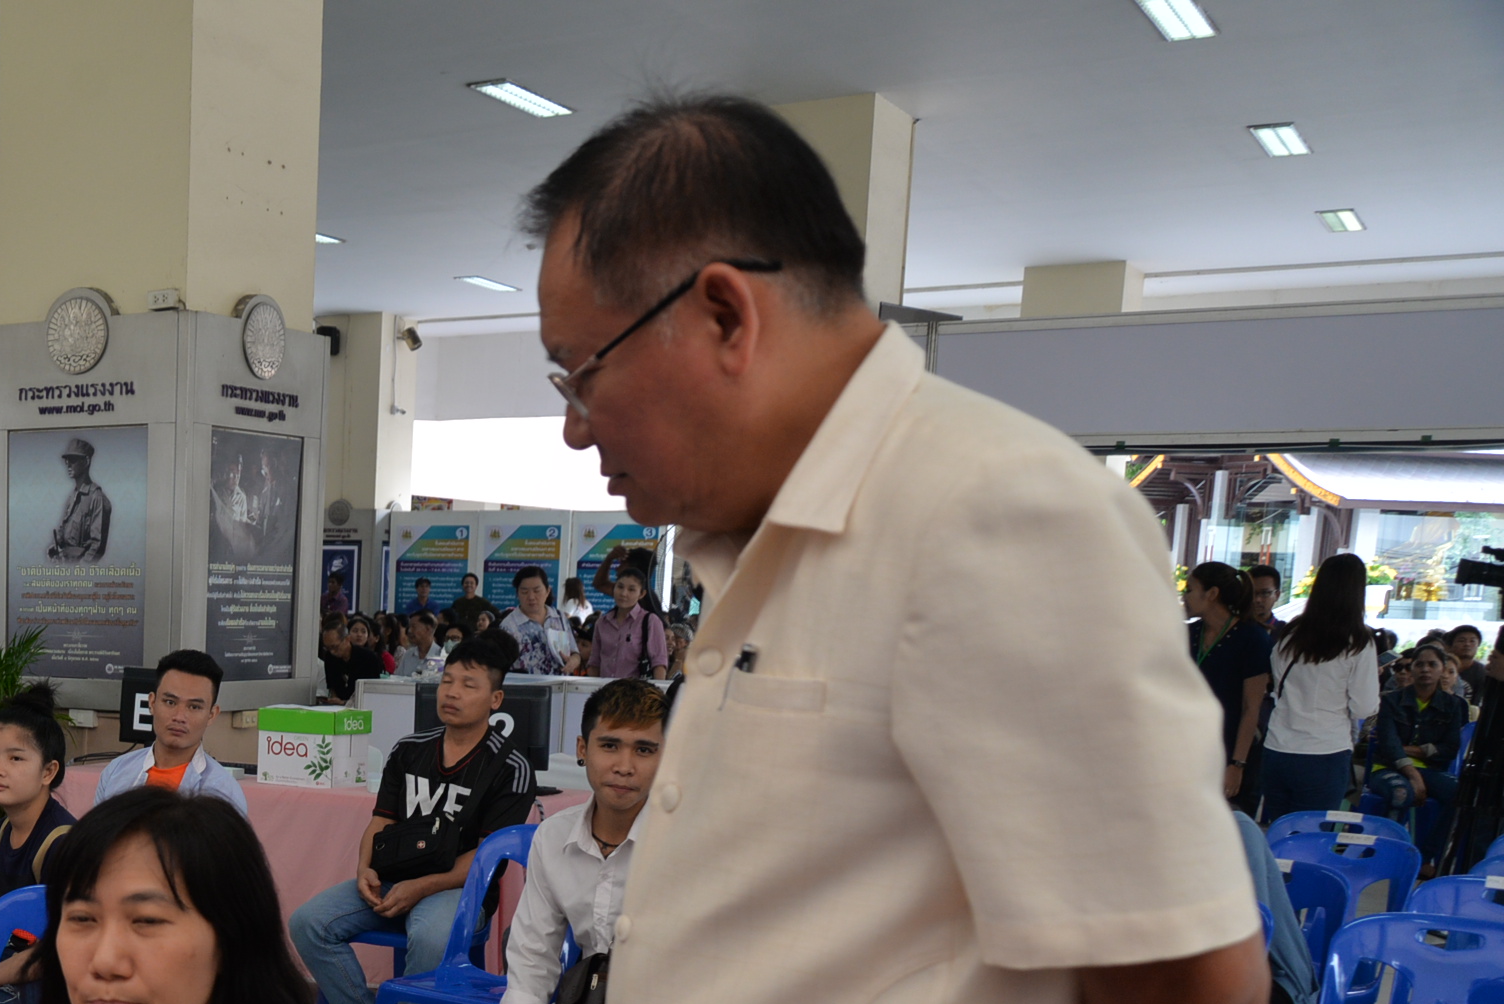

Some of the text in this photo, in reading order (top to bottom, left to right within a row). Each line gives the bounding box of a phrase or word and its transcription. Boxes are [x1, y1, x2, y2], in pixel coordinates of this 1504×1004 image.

[18, 380, 136, 401] กระทรวงแรงงาน
[38, 400, 114, 415] www.mol.go.th
[459, 529, 464, 537] 1
[548, 528, 556, 537] 2
[646, 527, 653, 537] 3
[266, 735, 308, 758] idea
